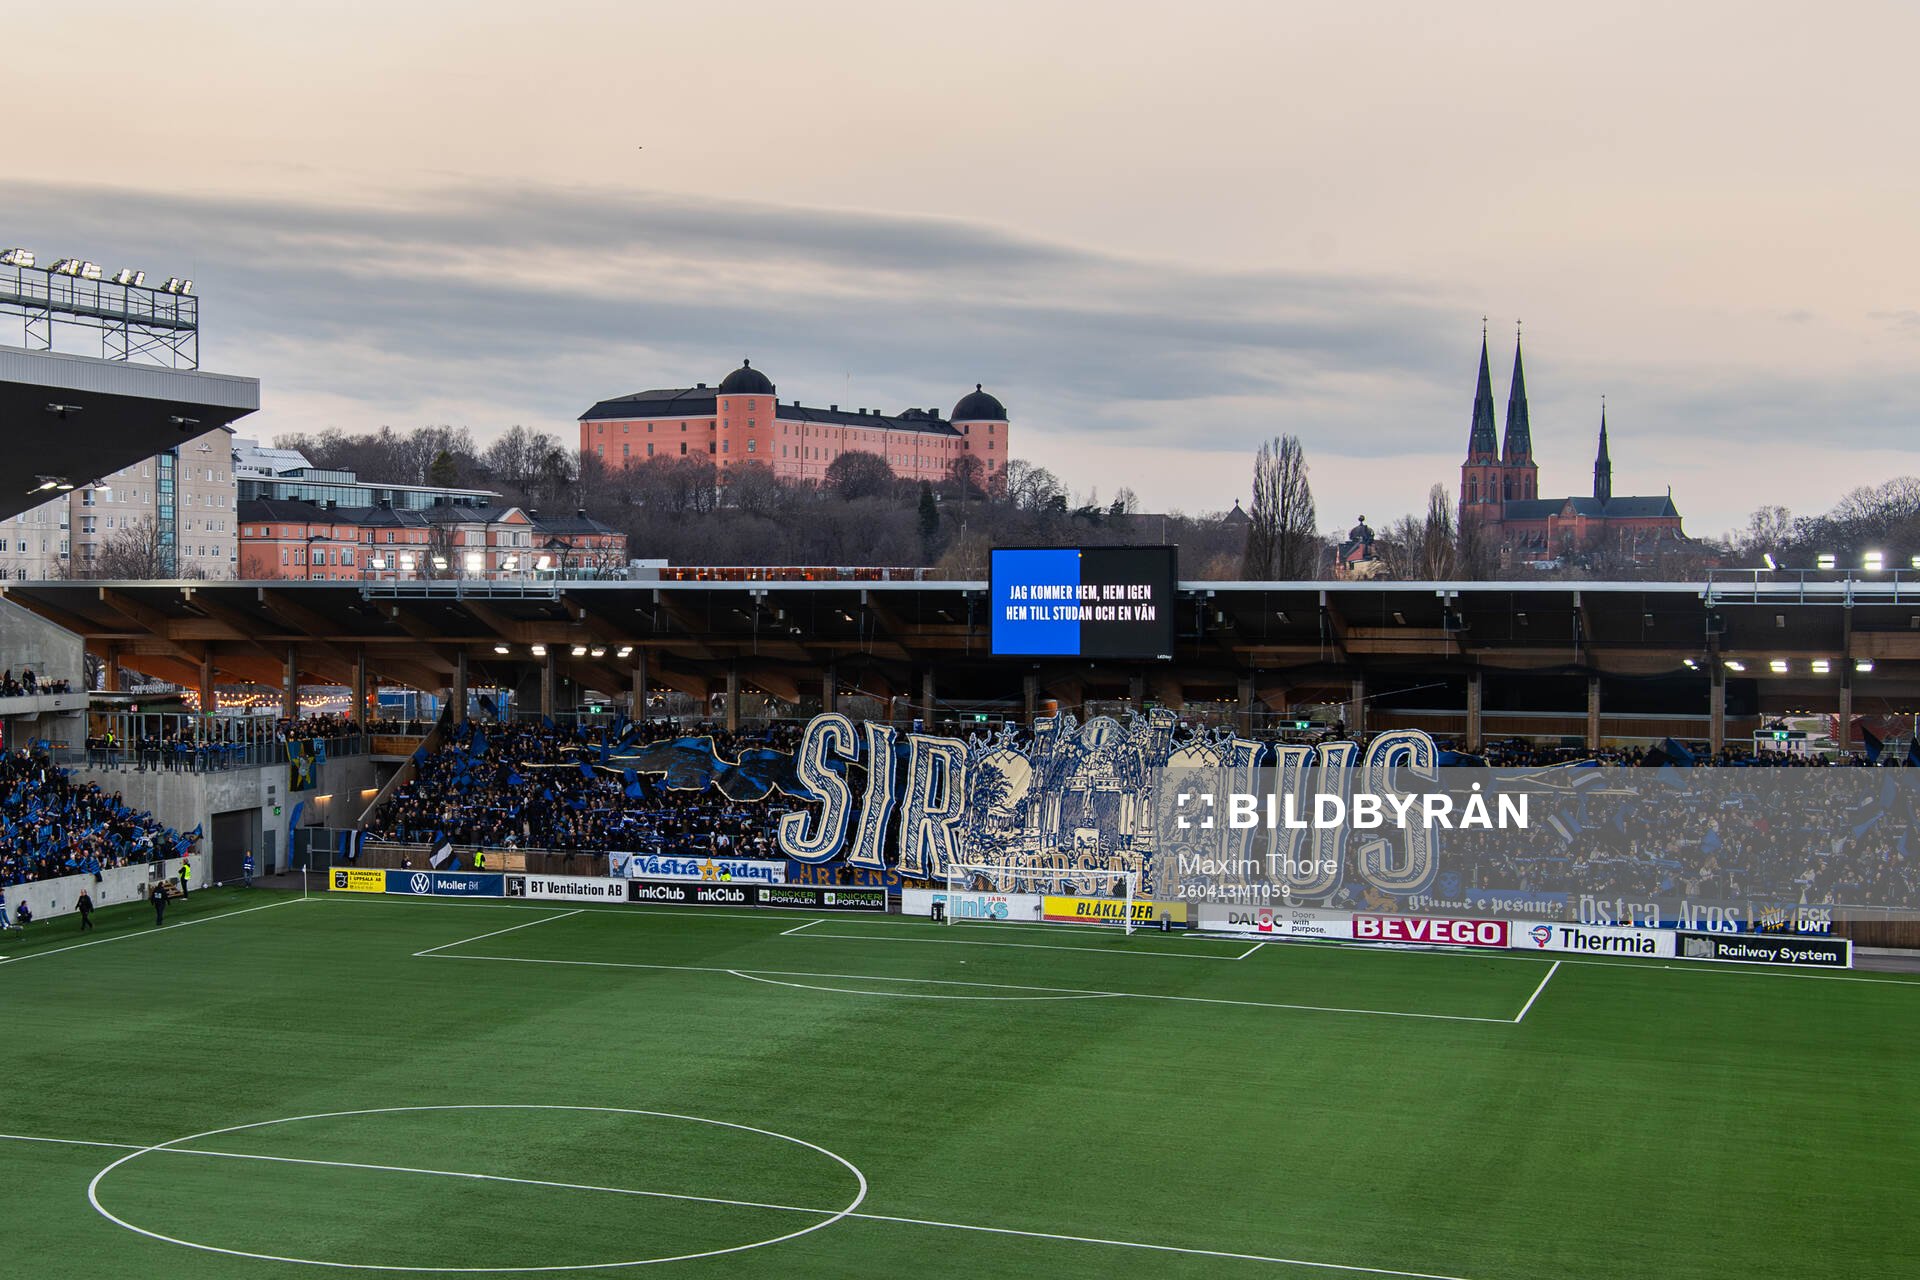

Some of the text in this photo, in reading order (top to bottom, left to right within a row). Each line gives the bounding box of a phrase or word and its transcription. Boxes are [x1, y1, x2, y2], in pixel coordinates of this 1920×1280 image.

[1010, 585, 1151, 602] JAG KOMMER HEM, HEM IGEN
[1006, 603, 1156, 621] HEM TILL STUDAN OCH EN VÄN
[634, 855, 700, 876] Västra
[531, 881, 622, 897] BT Ventilation AB
[638, 885, 685, 901] inkClub
[697, 887, 745, 902] inkClub
[771, 889, 816, 898] SNICKERI
[837, 892, 883, 901] SNICKERI
[771, 896, 816, 905] PORTALEN
[836, 898, 883, 907] PORTALEN
[1076, 900, 1153, 919] BLÅKLÄDER
[1292, 910, 1316, 919] Doors
[1579, 894, 1660, 928] Östra
[1676, 900, 1740, 933] Aros
[1798, 907, 1831, 921] FCK
[1228, 911, 1283, 928] DALOC
[1798, 920, 1831, 932] UNT
[1357, 916, 1501, 944] BEVEGO
[1560, 928, 1656, 954] Thermia
[1718, 944, 1837, 962] Railway System
